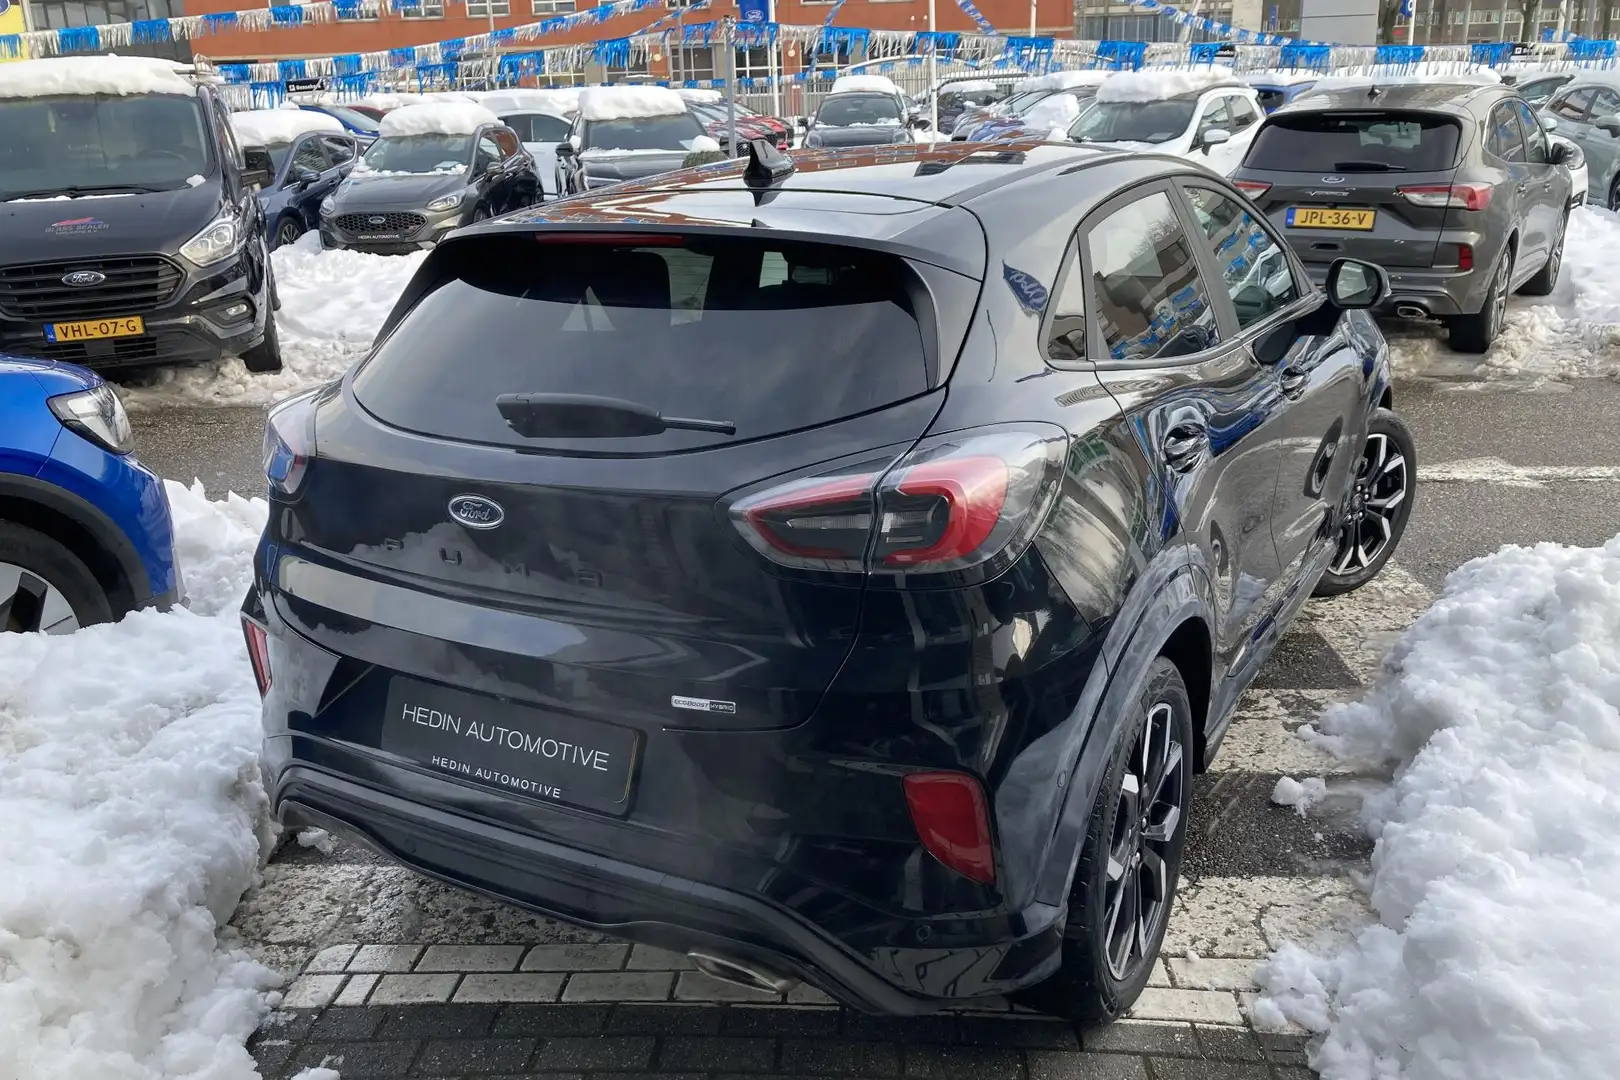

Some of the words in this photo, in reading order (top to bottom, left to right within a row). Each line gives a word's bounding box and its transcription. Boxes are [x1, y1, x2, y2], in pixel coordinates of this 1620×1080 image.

[1300, 211, 1367, 225] JPL-36-V
[71, 273, 95, 283] Ford
[59, 320, 137, 338] VHL-07-G
[460, 501, 491, 521] Ford
[402, 703, 461, 734] HEDIN
[465, 721, 610, 772] AUTOMOTIVE
[432, 755, 471, 774] HEDIN
[475, 767, 562, 799] AUTOMOTIVE
